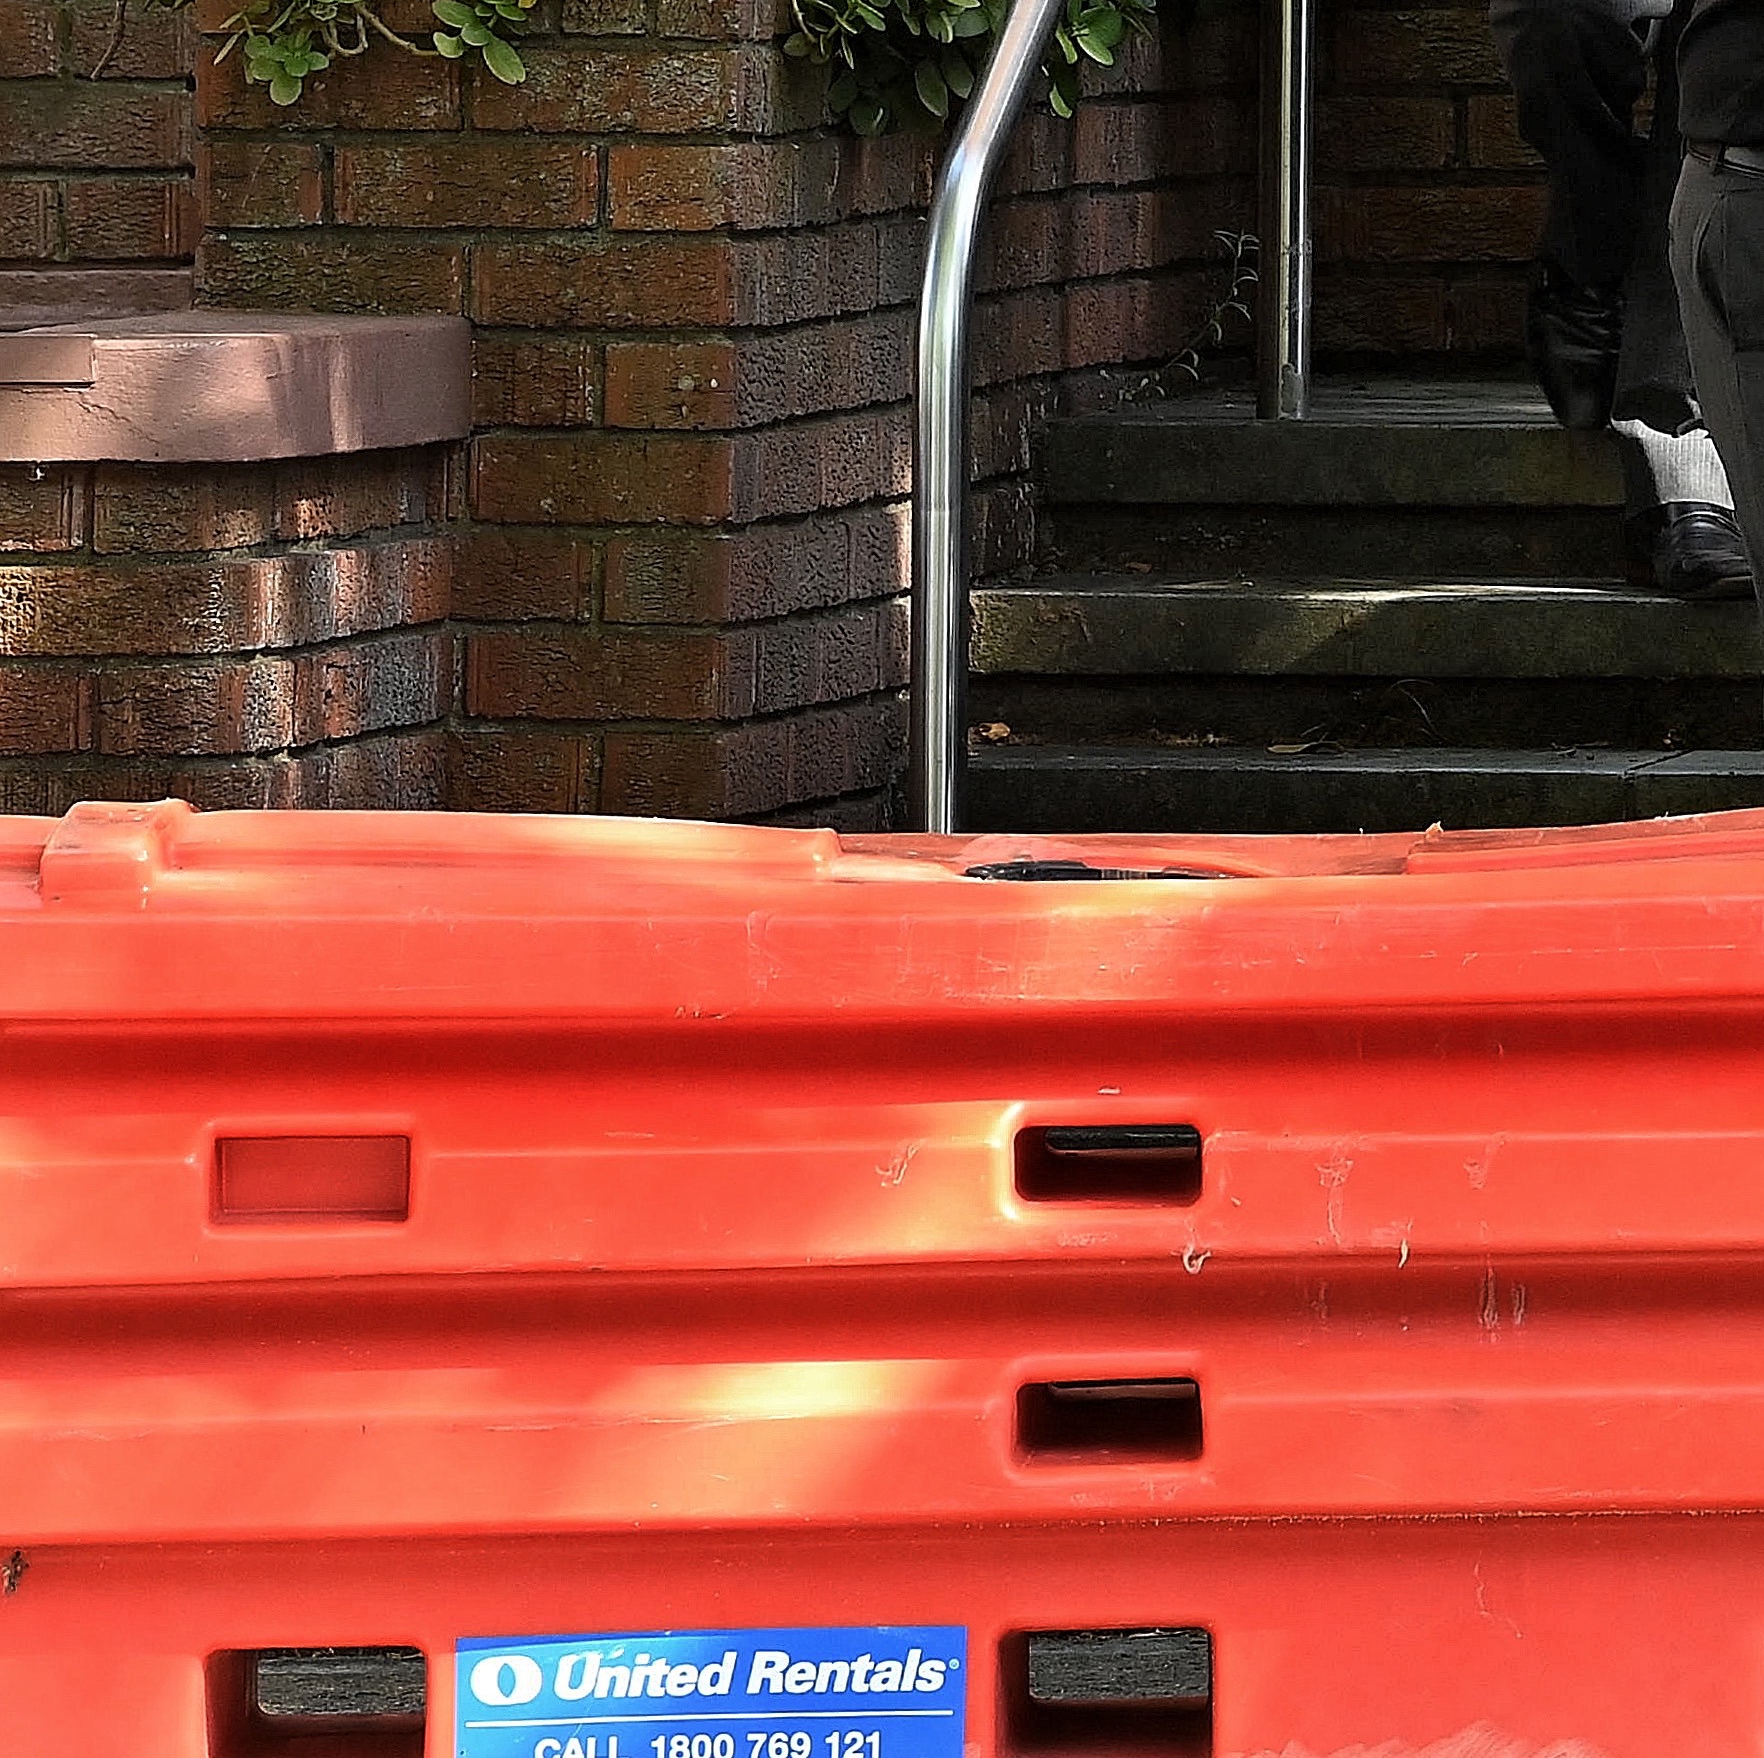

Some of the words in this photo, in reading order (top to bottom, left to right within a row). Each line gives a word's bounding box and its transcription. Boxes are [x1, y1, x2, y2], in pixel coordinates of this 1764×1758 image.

[553, 1650, 738, 1702] United
[746, 1648, 947, 1694] Rentals
[533, 1735, 629, 1758] CALL
[650, 1733, 735, 1758] 1800
[746, 1731, 812, 1758] 769
[825, 1730, 882, 1758] 121
